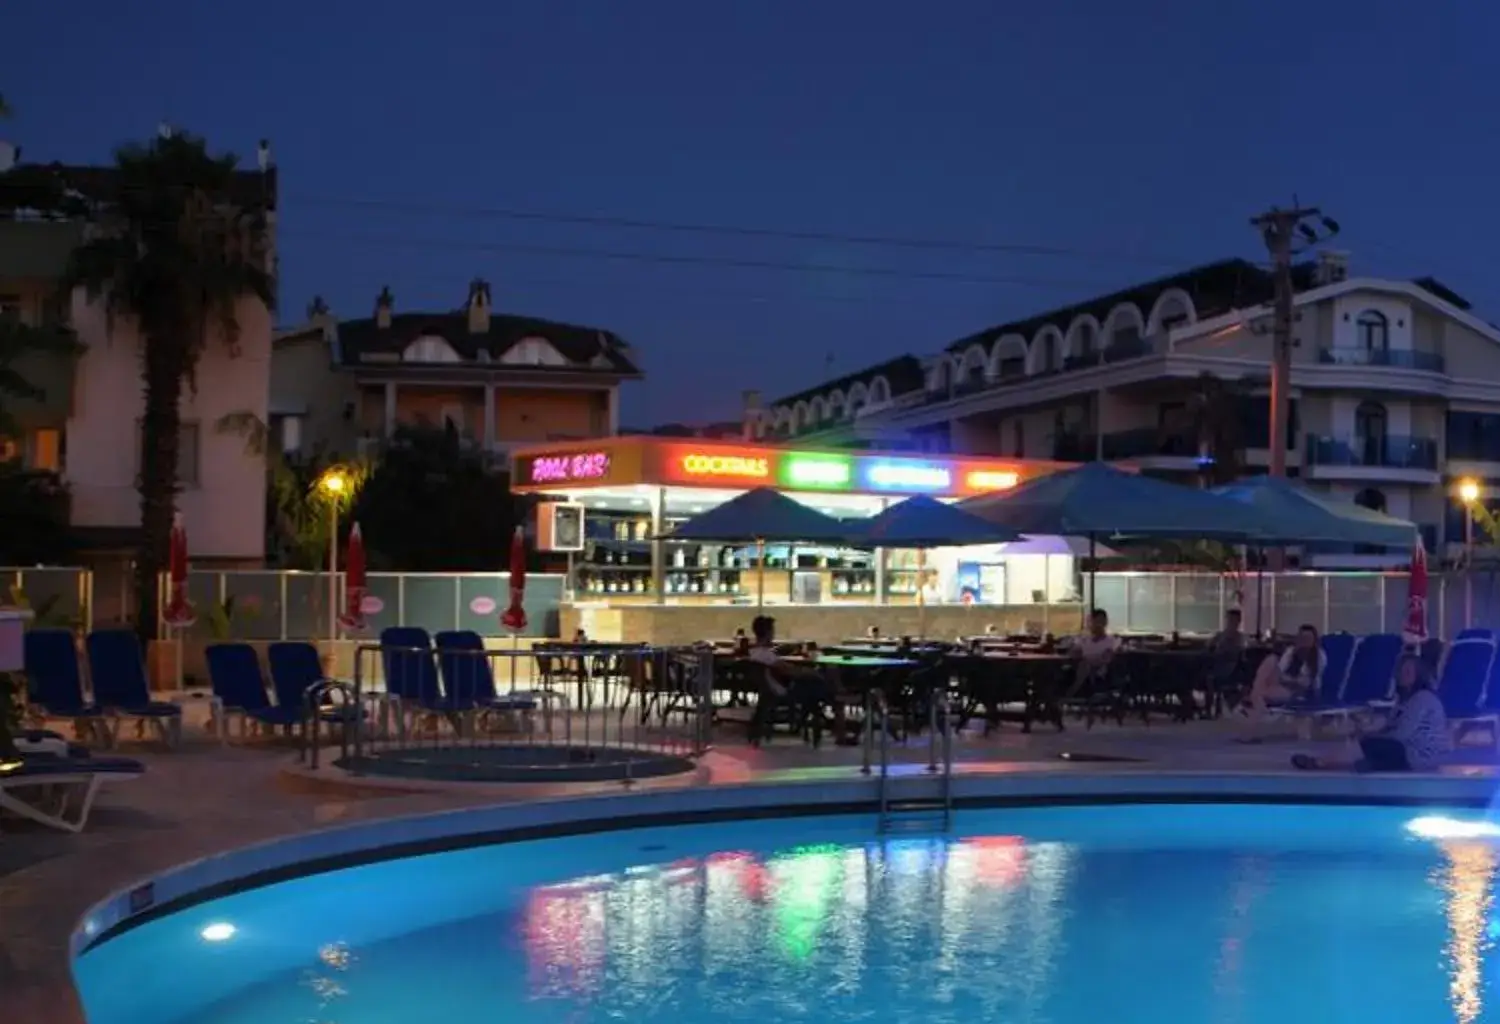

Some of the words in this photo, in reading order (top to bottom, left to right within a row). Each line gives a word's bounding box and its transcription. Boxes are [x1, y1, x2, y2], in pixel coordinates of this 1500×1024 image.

[532, 457, 569, 480] POOL
[572, 453, 609, 477] BAR
[684, 455, 768, 477] COCKTAILS
